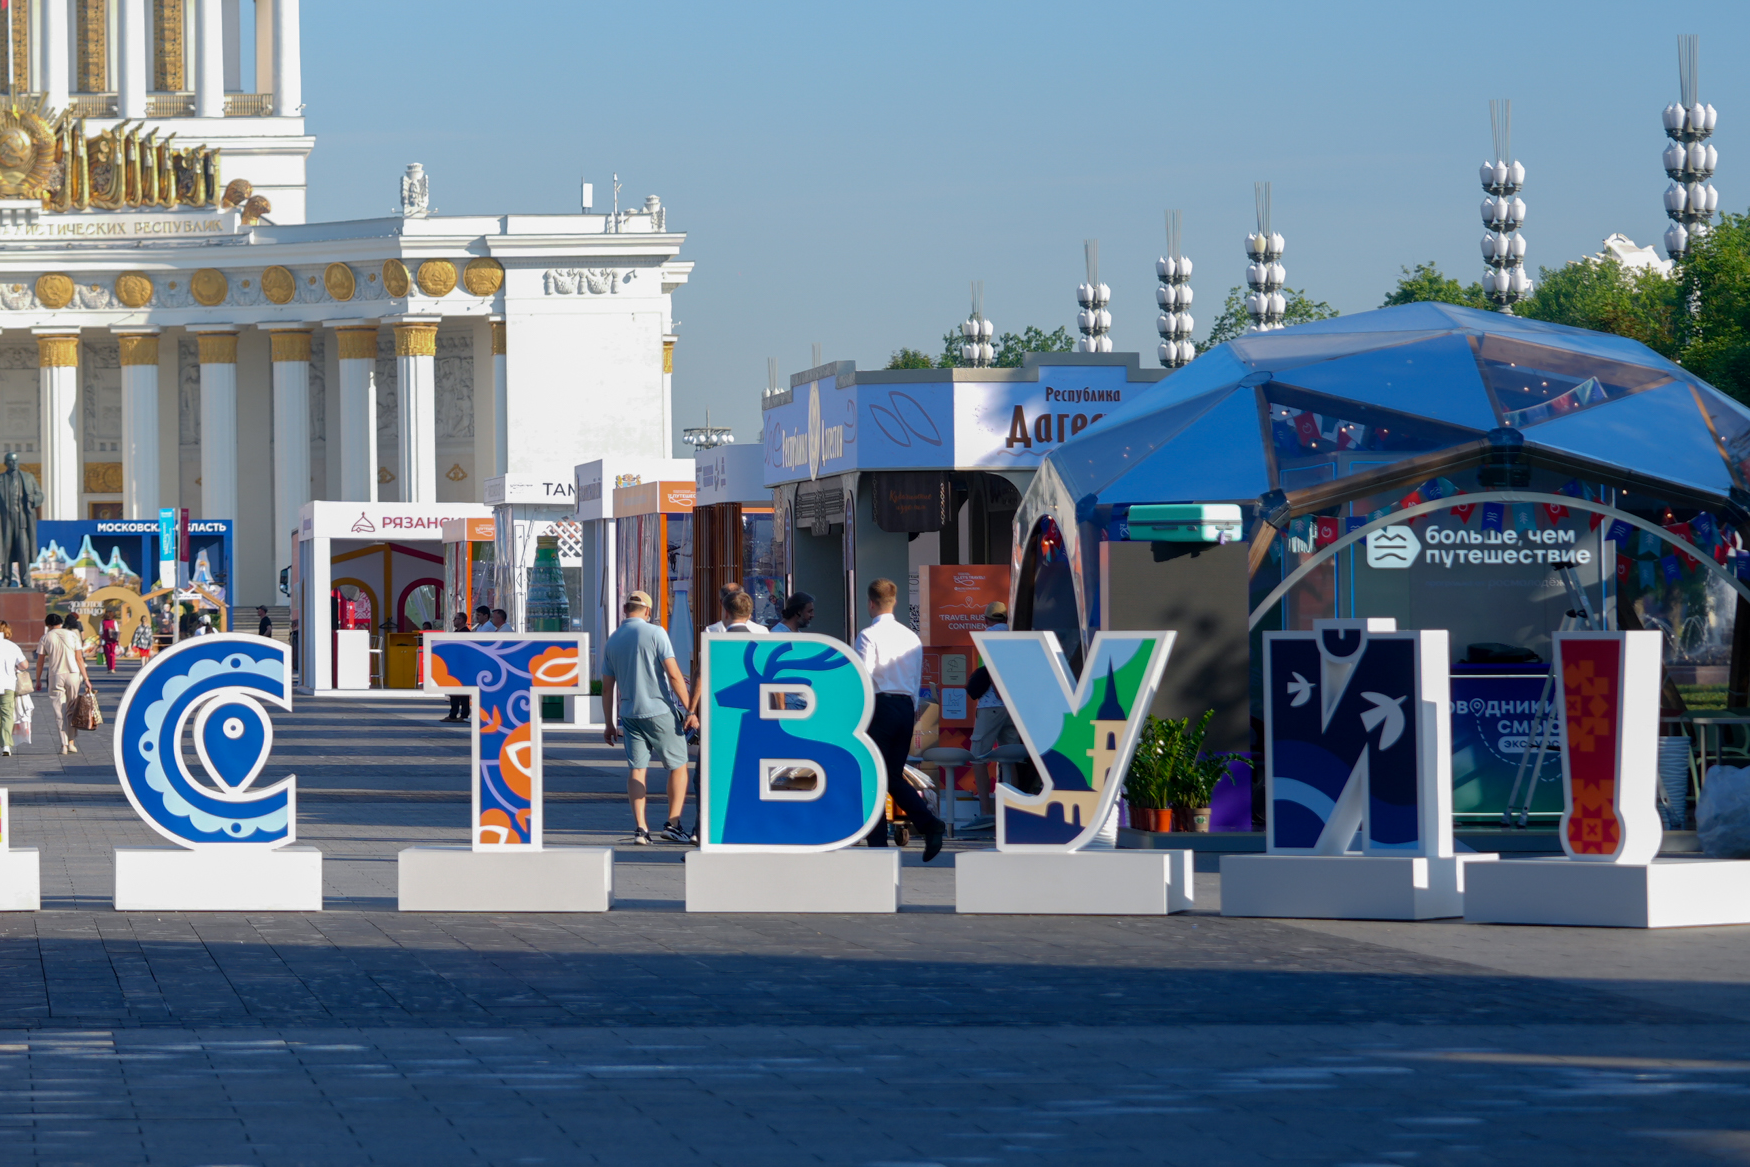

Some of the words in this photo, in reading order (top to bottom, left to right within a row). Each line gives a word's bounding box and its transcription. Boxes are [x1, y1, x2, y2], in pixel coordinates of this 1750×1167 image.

[134, 219, 224, 234] РЕСПУБЛИК
[1046, 386, 1121, 403] Республика
[1006, 405, 1108, 448] Даге
[97, 523, 161, 532] МОСКОВСК
[1425, 525, 1523, 546] больше,
[1528, 529, 1575, 544] чем
[1425, 548, 1592, 568] путешествие
